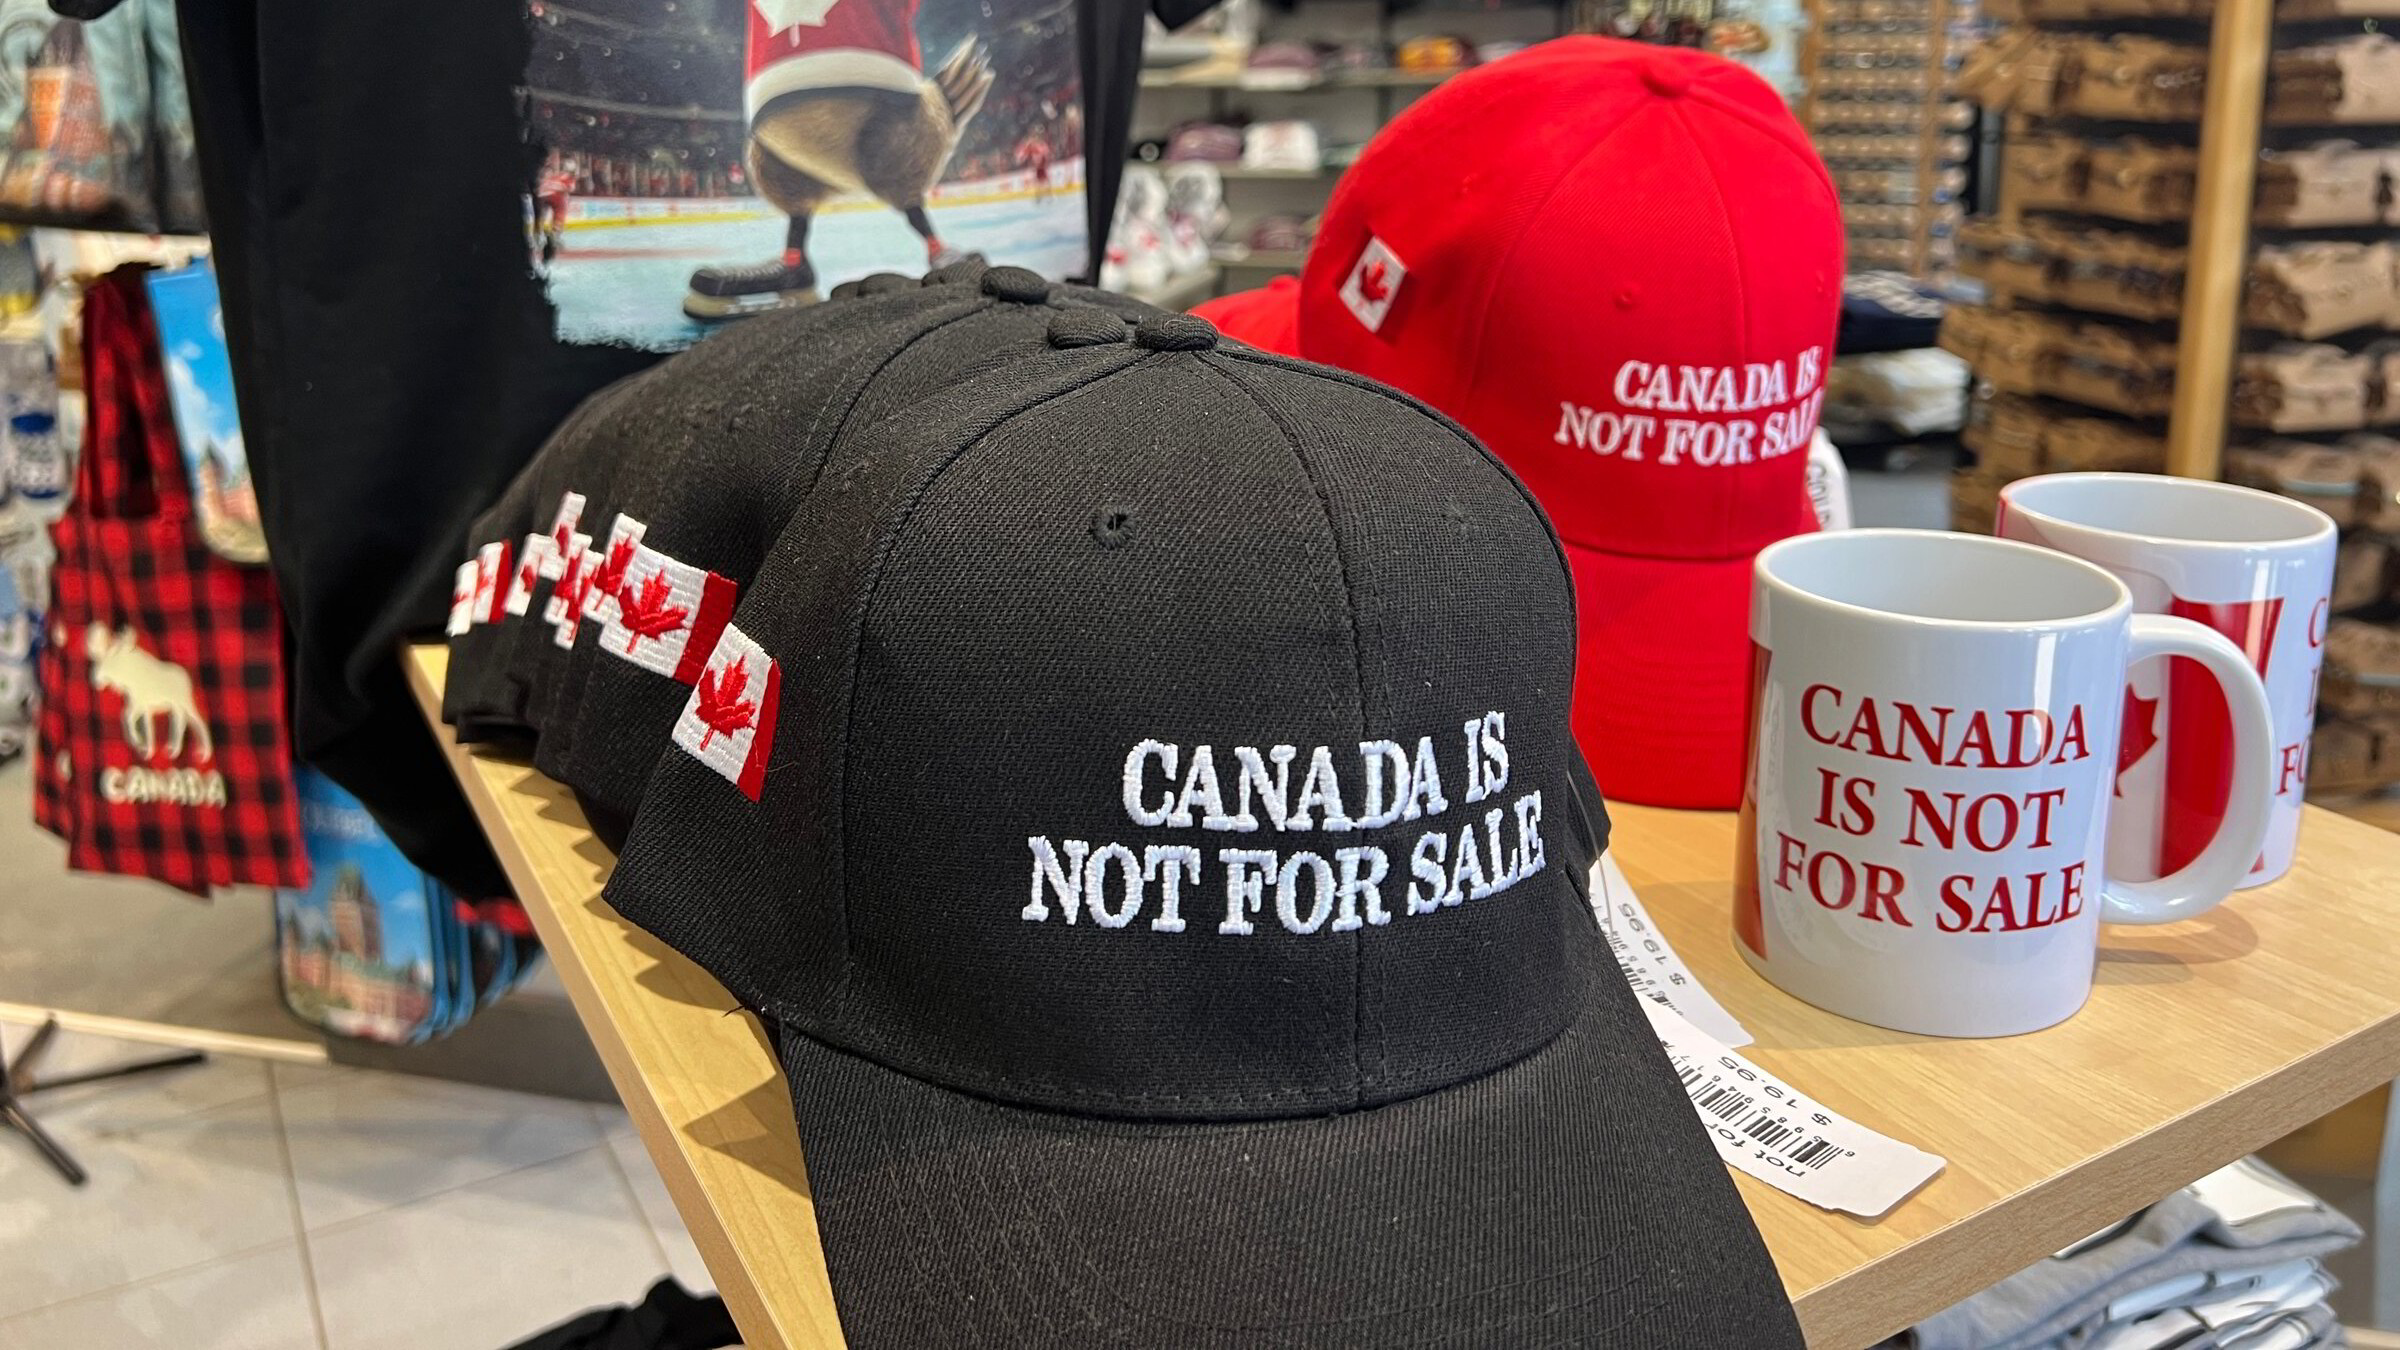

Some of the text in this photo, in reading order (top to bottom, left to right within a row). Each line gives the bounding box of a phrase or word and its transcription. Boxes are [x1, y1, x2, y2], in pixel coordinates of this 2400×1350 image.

[1614, 346, 1823, 413] CANADA IS
[1554, 402, 1656, 460] NOT
[1658, 419, 1756, 466] FOR
[1800, 683, 2091, 769] CANADA
[99, 765, 228, 811] CANADA
[1122, 710, 1510, 833] CANADA IS
[1813, 766, 2067, 853] IS NOT
[1021, 789, 1547, 936] NOT FOR SALE
[1773, 830, 2087, 934] FOR SALE
[1618, 903, 1668, 966] 19.95
[1718, 1055, 1833, 1127] $ 19.95
[1754, 1149, 1806, 1178] not
